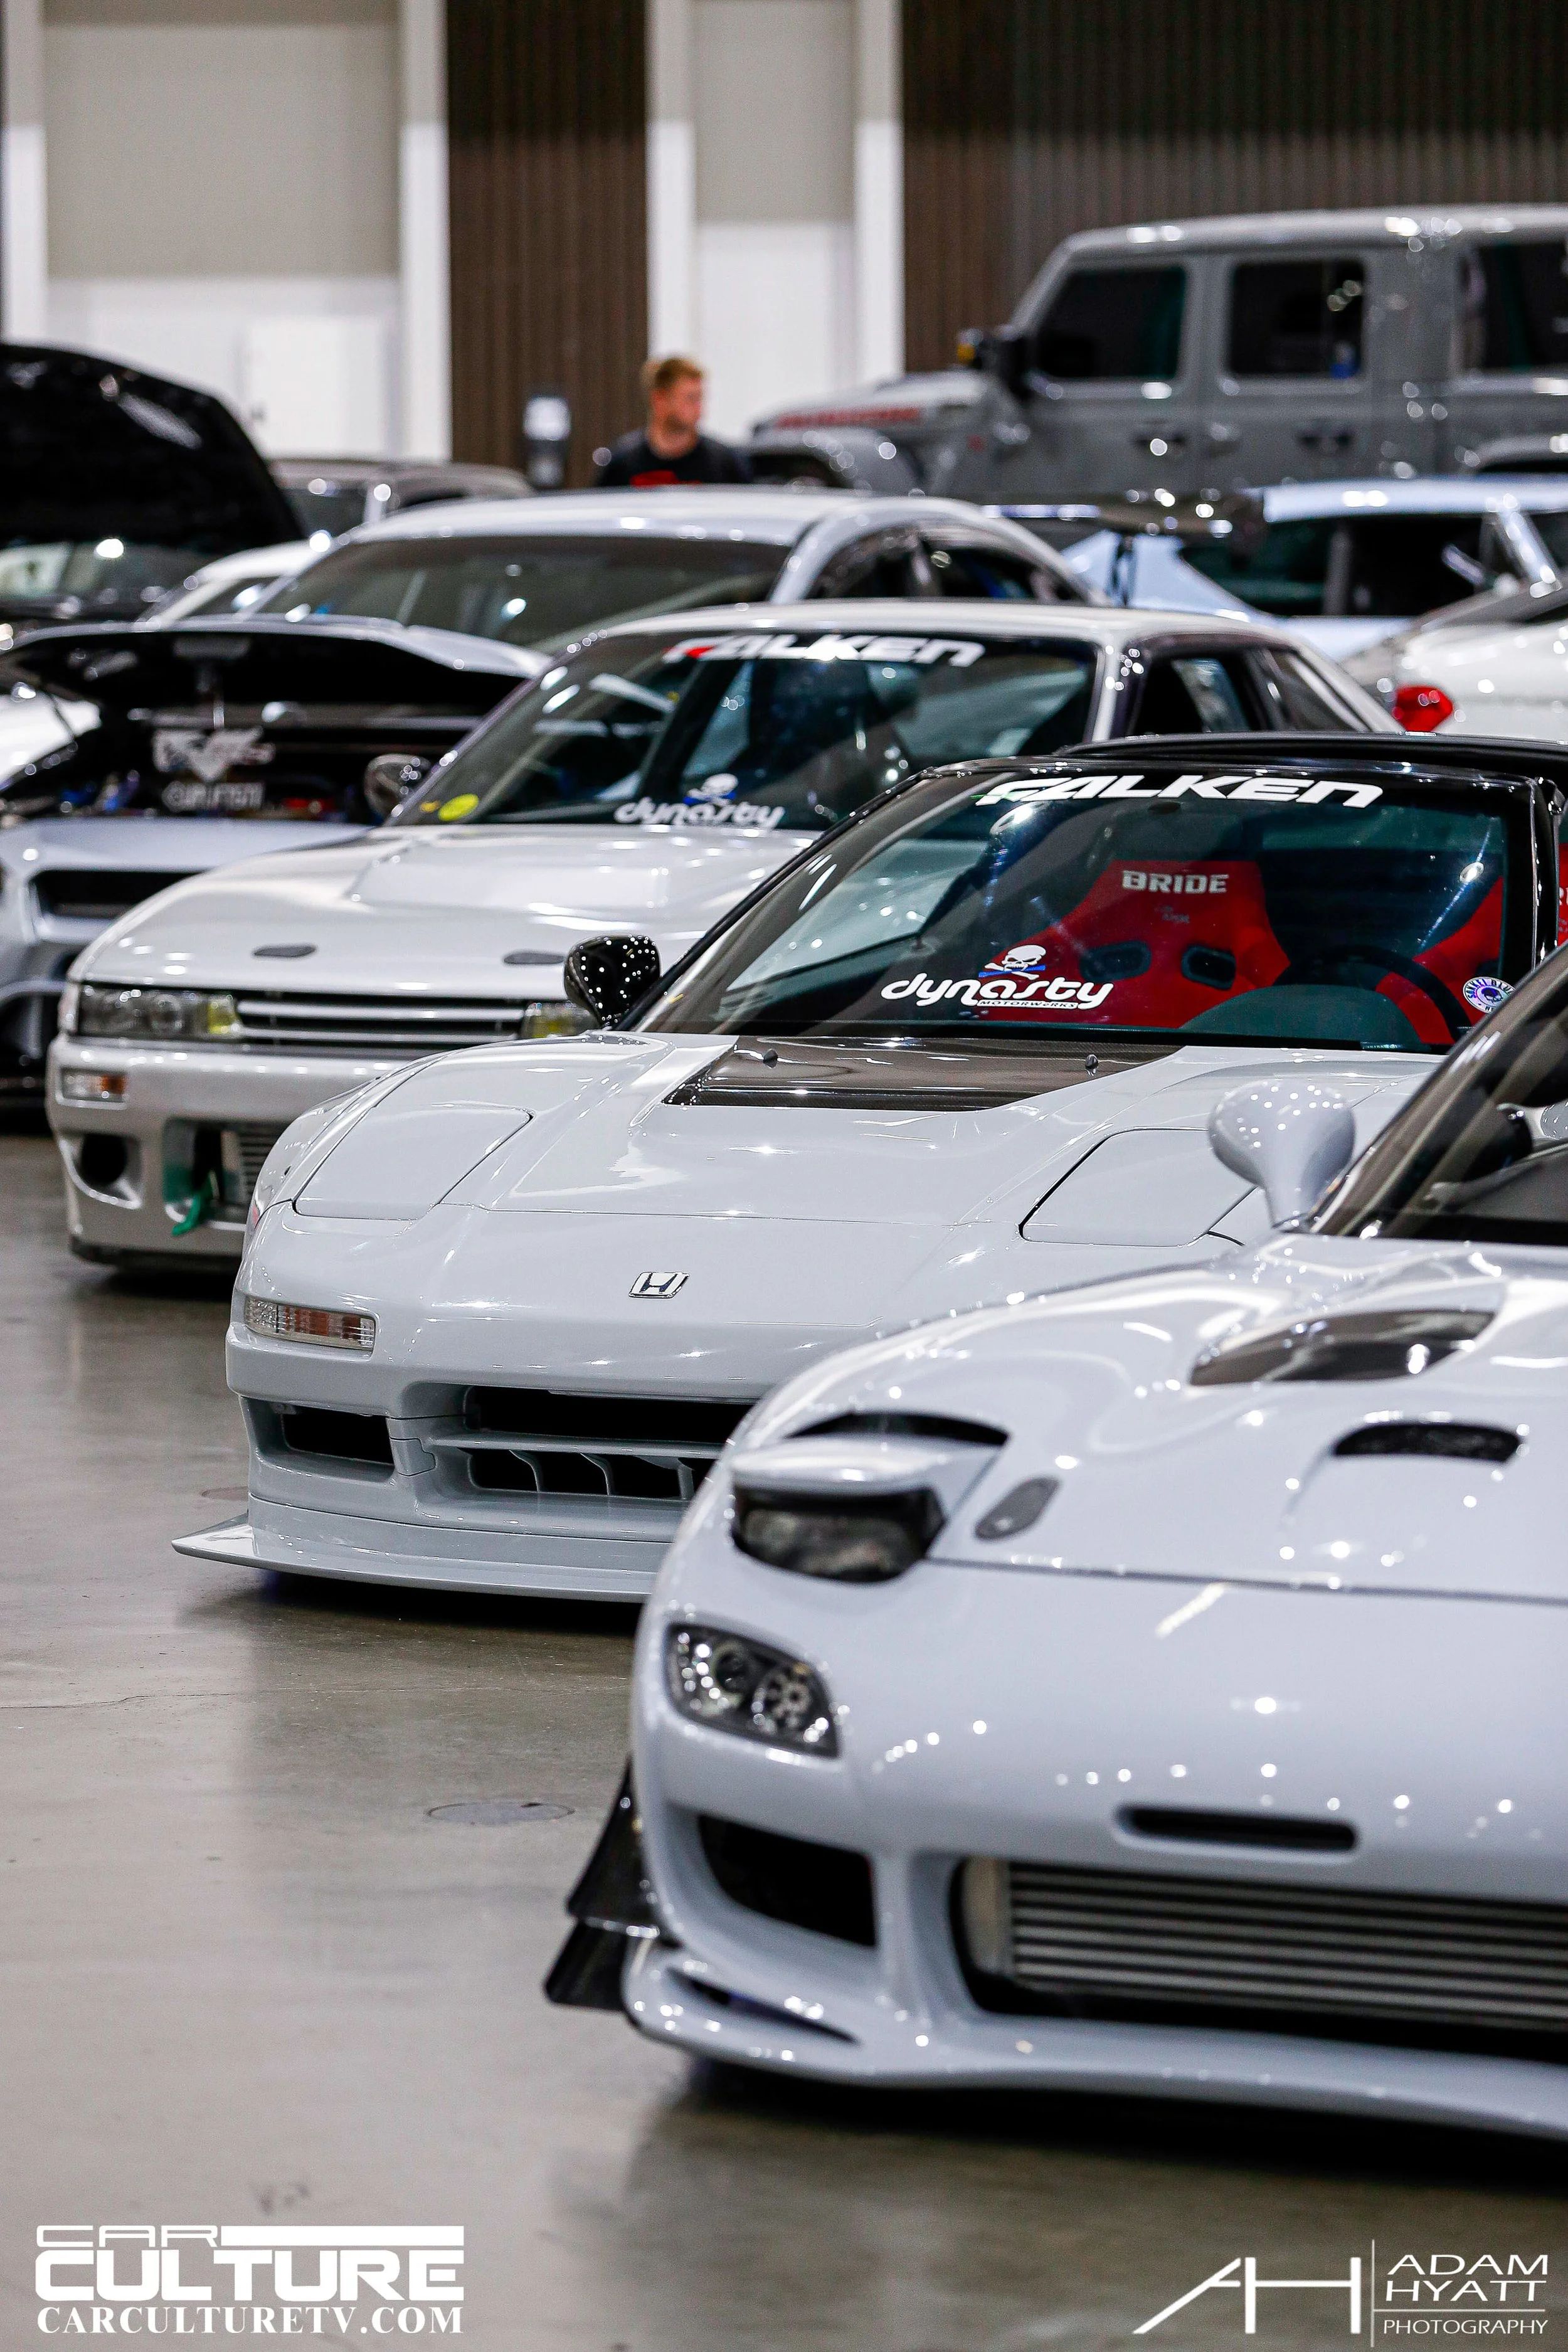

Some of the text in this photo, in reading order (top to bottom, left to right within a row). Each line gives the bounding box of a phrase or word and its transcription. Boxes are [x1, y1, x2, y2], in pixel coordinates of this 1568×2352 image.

[662, 634, 985, 667] FALKEN
[975, 775, 1384, 808] FALKEN
[1122, 871, 1229, 894] BRIDE
[881, 973, 1114, 1010] dynasty
